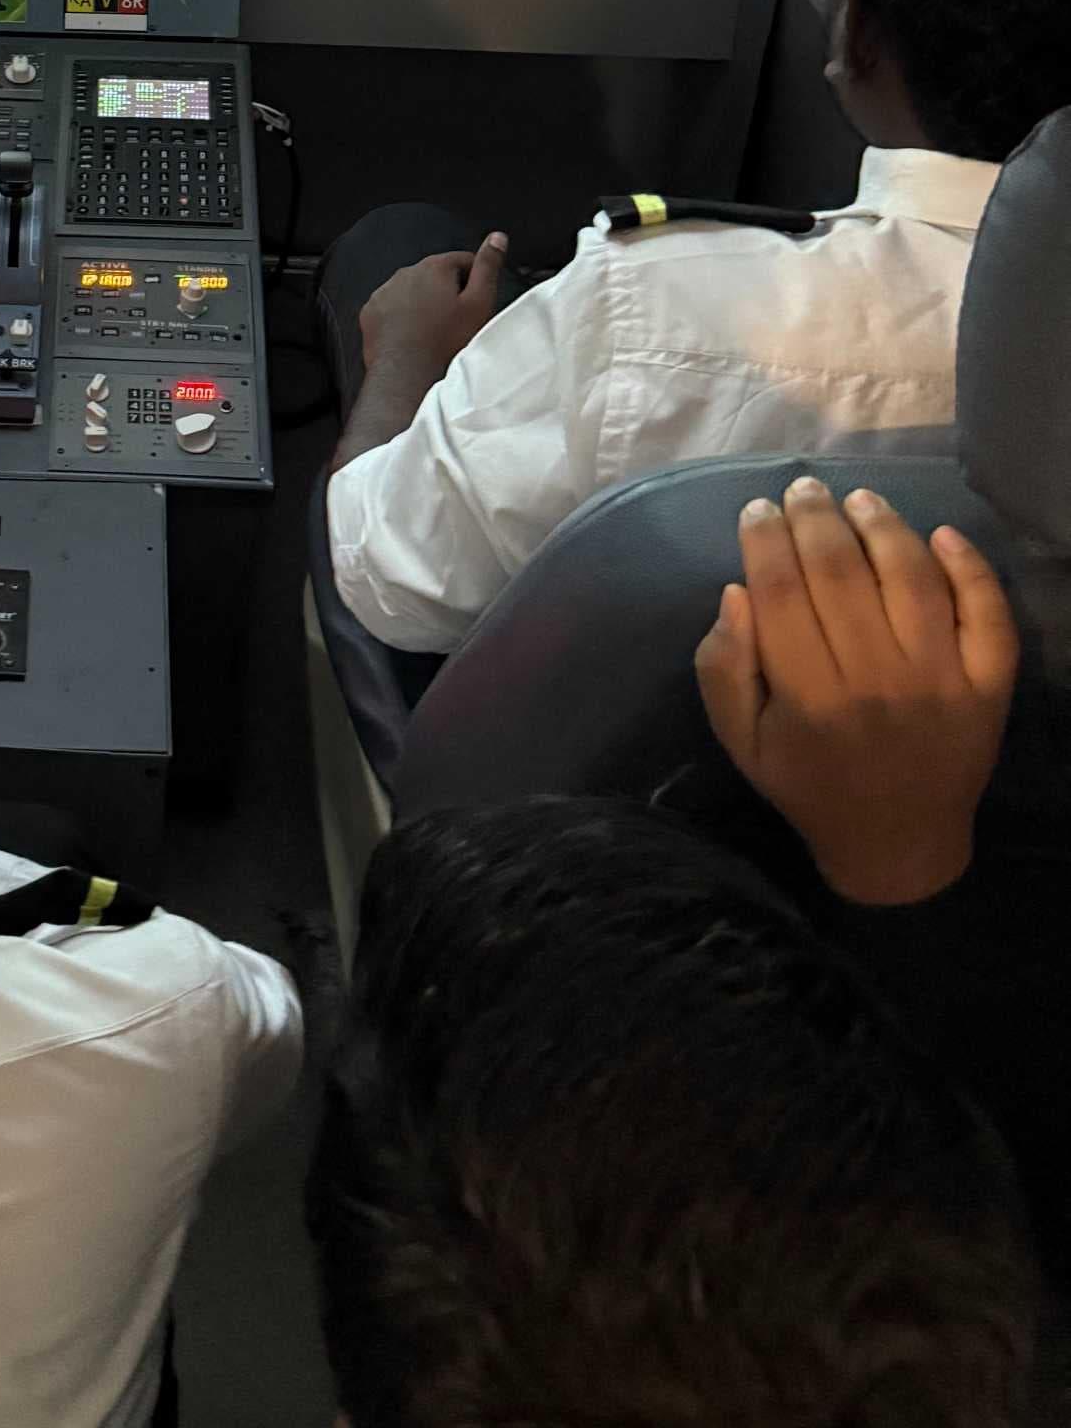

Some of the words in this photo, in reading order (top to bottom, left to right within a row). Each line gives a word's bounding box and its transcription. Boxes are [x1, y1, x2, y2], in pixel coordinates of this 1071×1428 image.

[81, 261, 129, 270] ACTIVE
[11, 358, 36, 370] BRK
[146, 390, 154, 398] 2
[176, 386, 216, 400] 2000
[129, 401, 139, 410] 4
[145, 402, 155, 410] 5
[130, 413, 138, 422] 7
